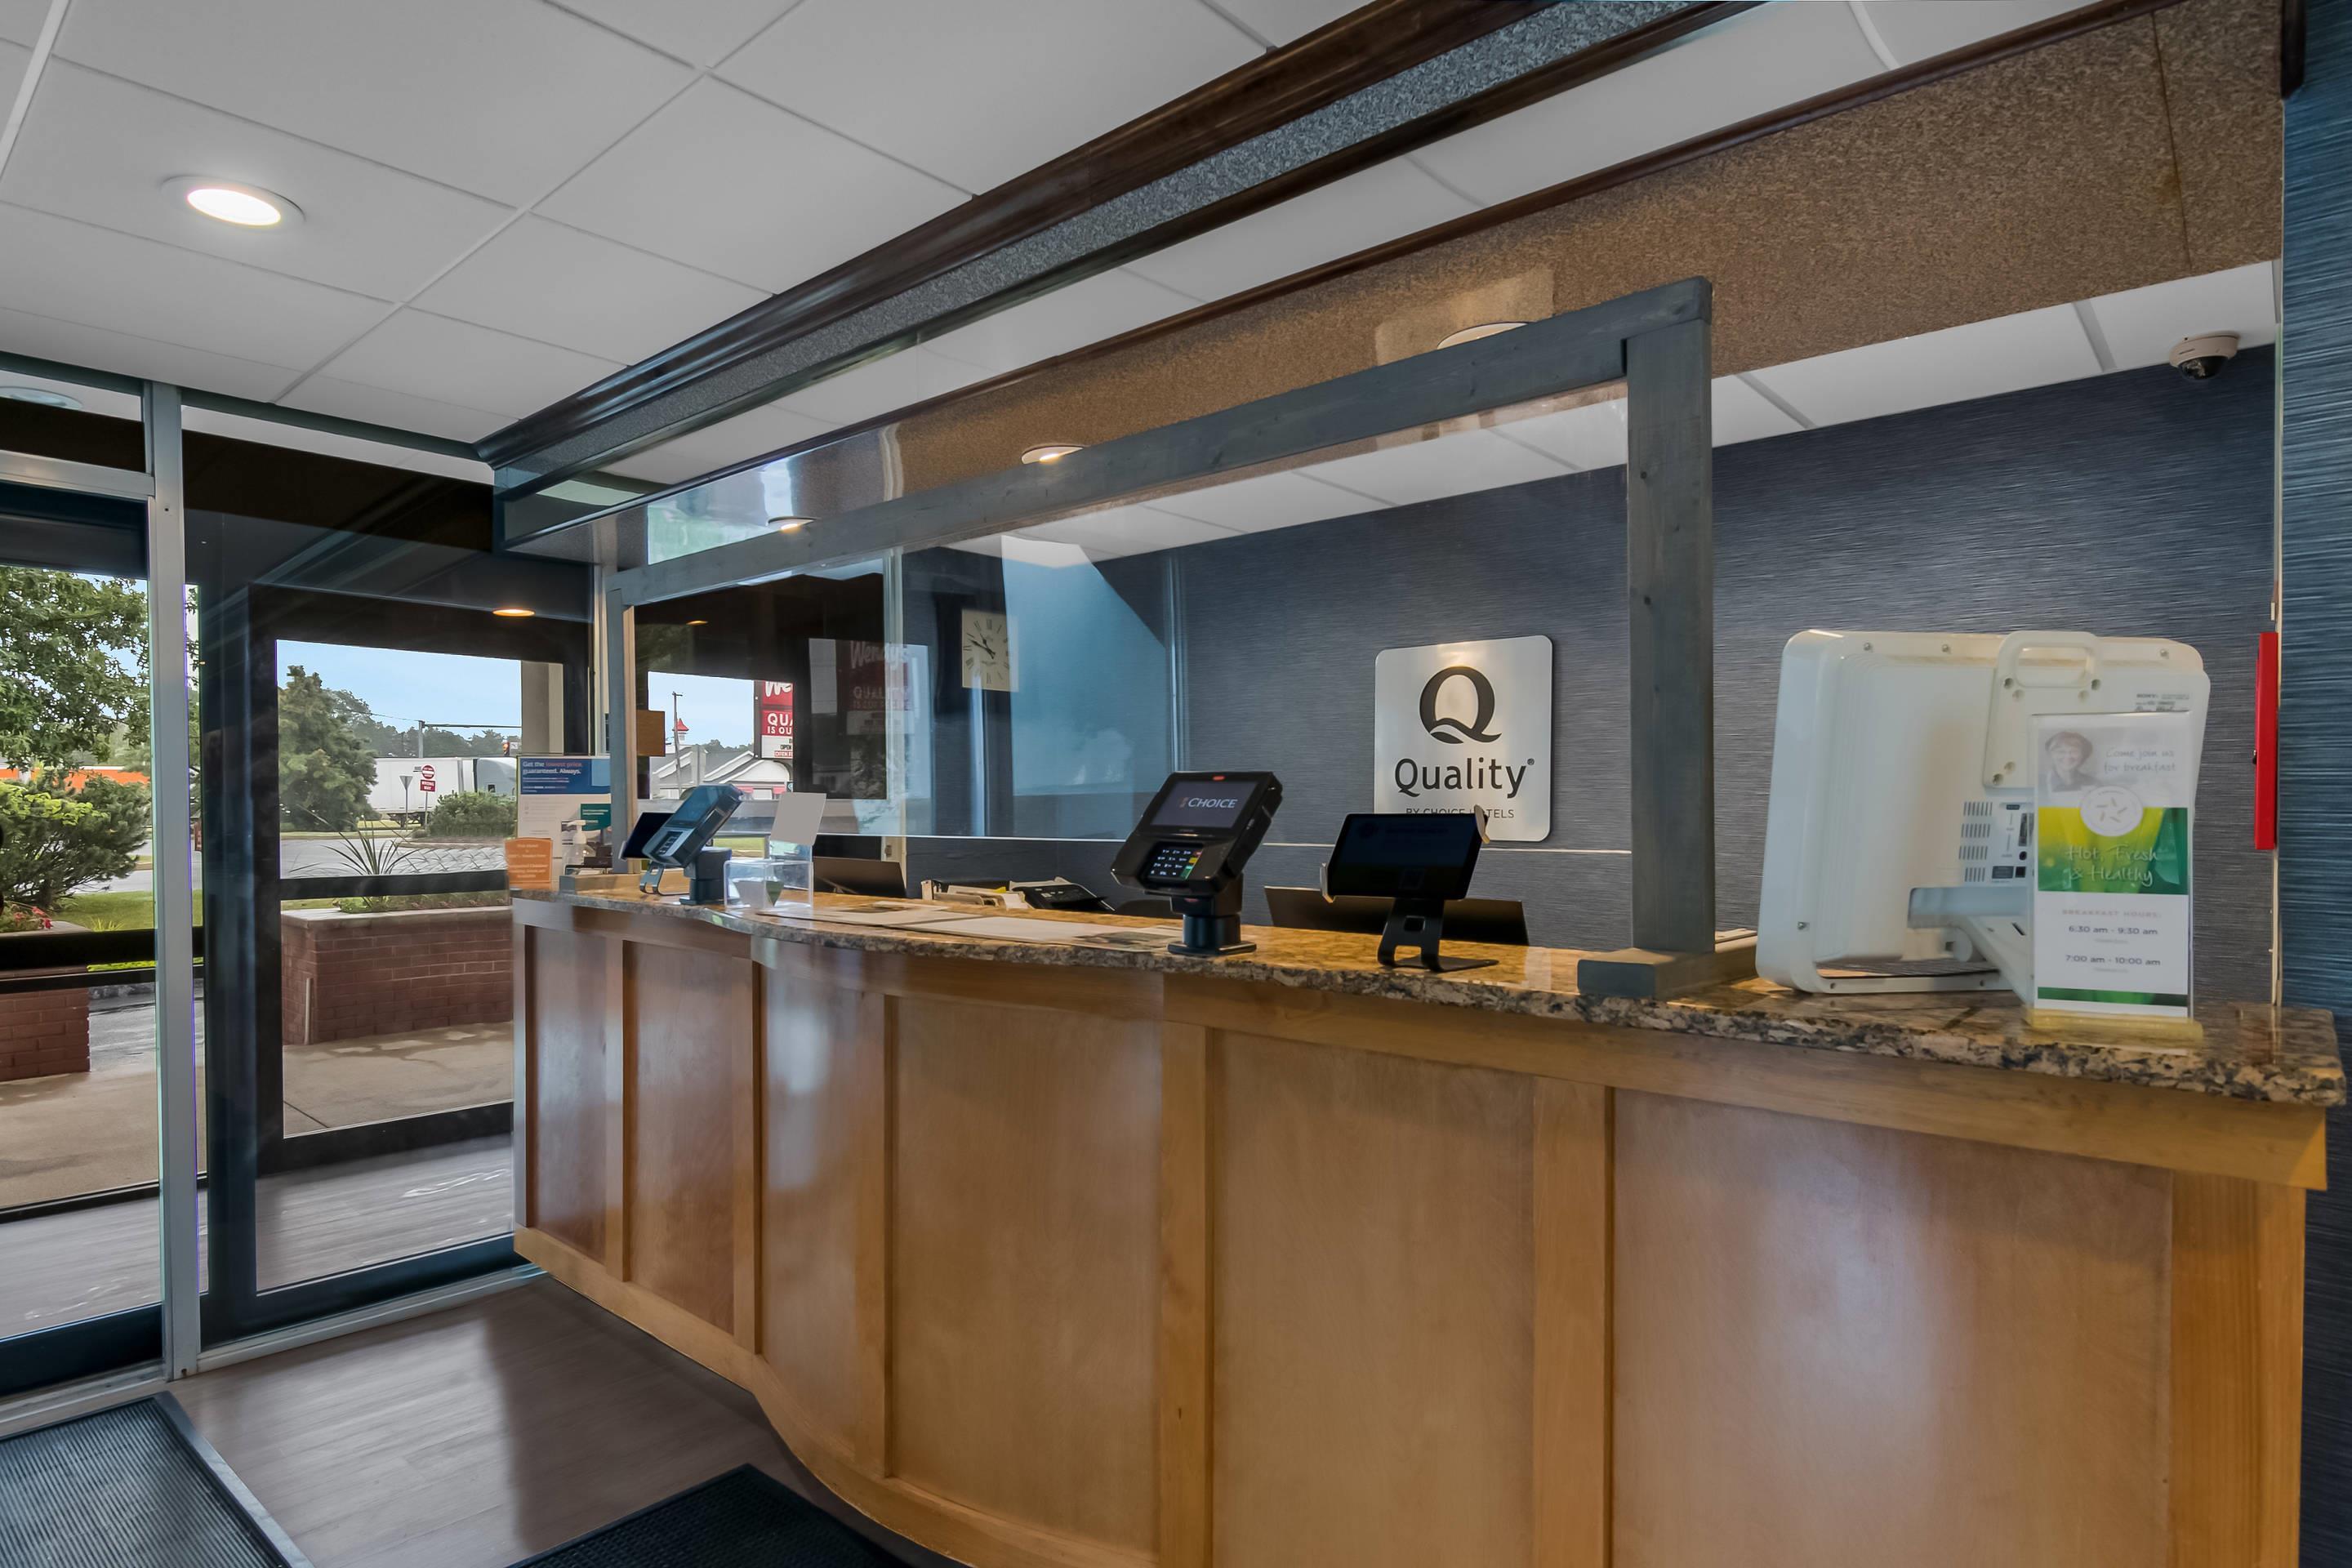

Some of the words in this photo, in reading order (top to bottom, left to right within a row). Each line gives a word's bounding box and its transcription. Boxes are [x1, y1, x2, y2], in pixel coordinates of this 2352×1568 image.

[2106, 746, 2135, 757] Come
[2136, 746, 2157, 760] join
[2104, 760, 2119, 774] for
[2123, 760, 2176, 774] breakfast
[1188, 797, 1238, 808] CHOICE
[1470, 808, 1515, 817] TELS
[2104, 844, 2158, 861] Fresh
[2091, 865, 2154, 887] Healthy
[2065, 954, 2087, 962] 7:00
[2115, 956, 2142, 964] 10:00
